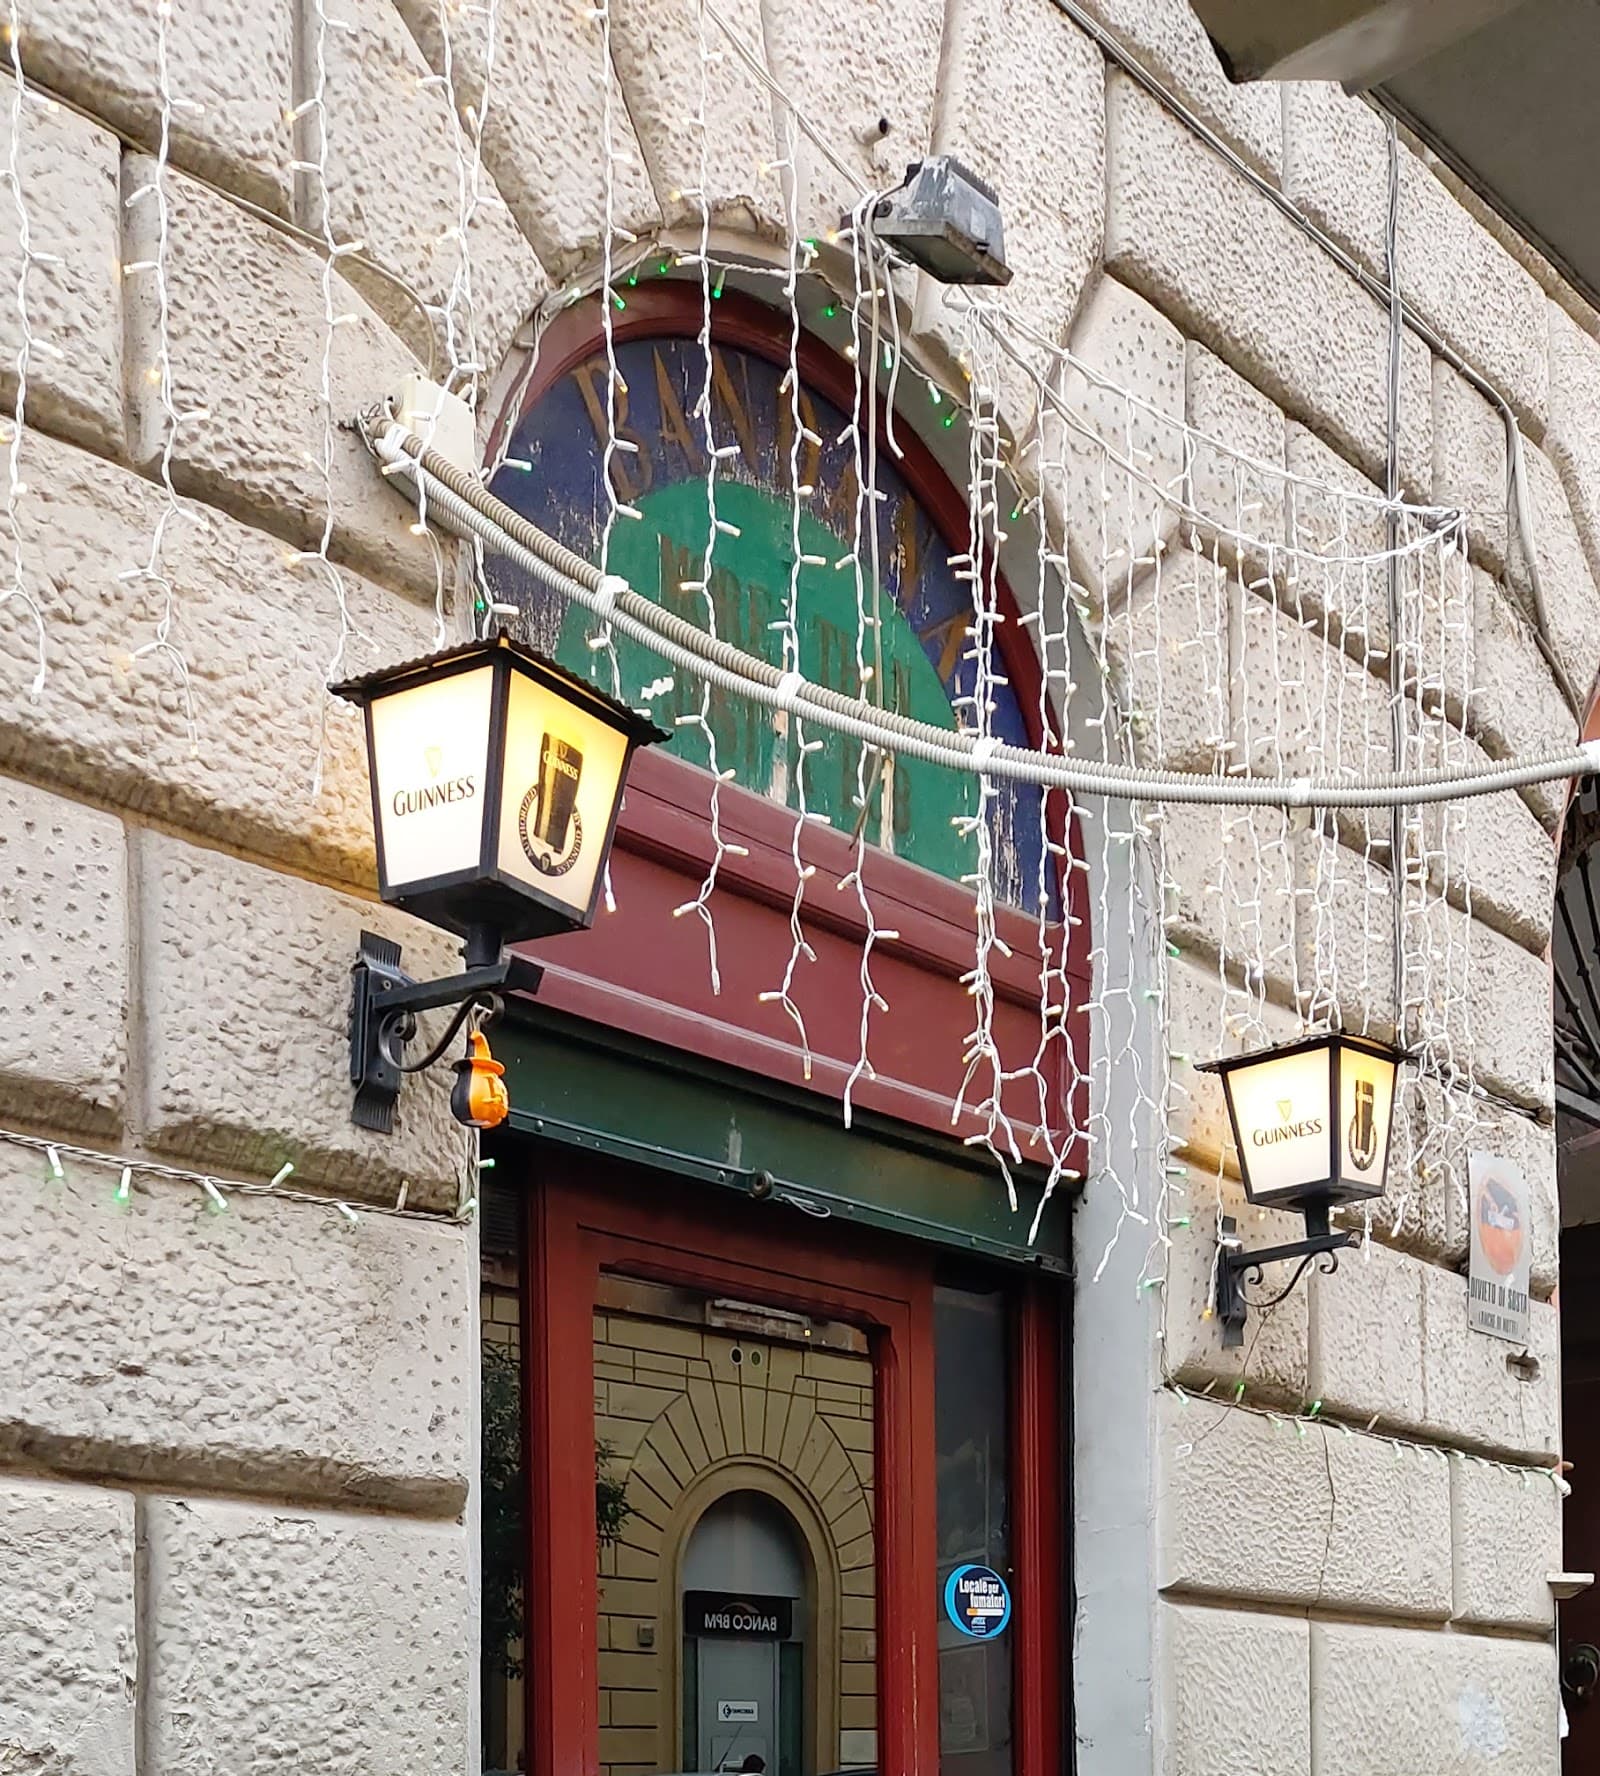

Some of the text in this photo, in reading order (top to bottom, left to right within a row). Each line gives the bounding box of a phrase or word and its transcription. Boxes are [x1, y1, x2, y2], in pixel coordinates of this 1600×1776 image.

[393, 775, 476, 818] GUINNESS
[1252, 1118, 1323, 1147] GUINNESS
[1470, 1276, 1527, 1313] DIVIETO DI SOSTA
[959, 1577, 988, 1594] Locale
